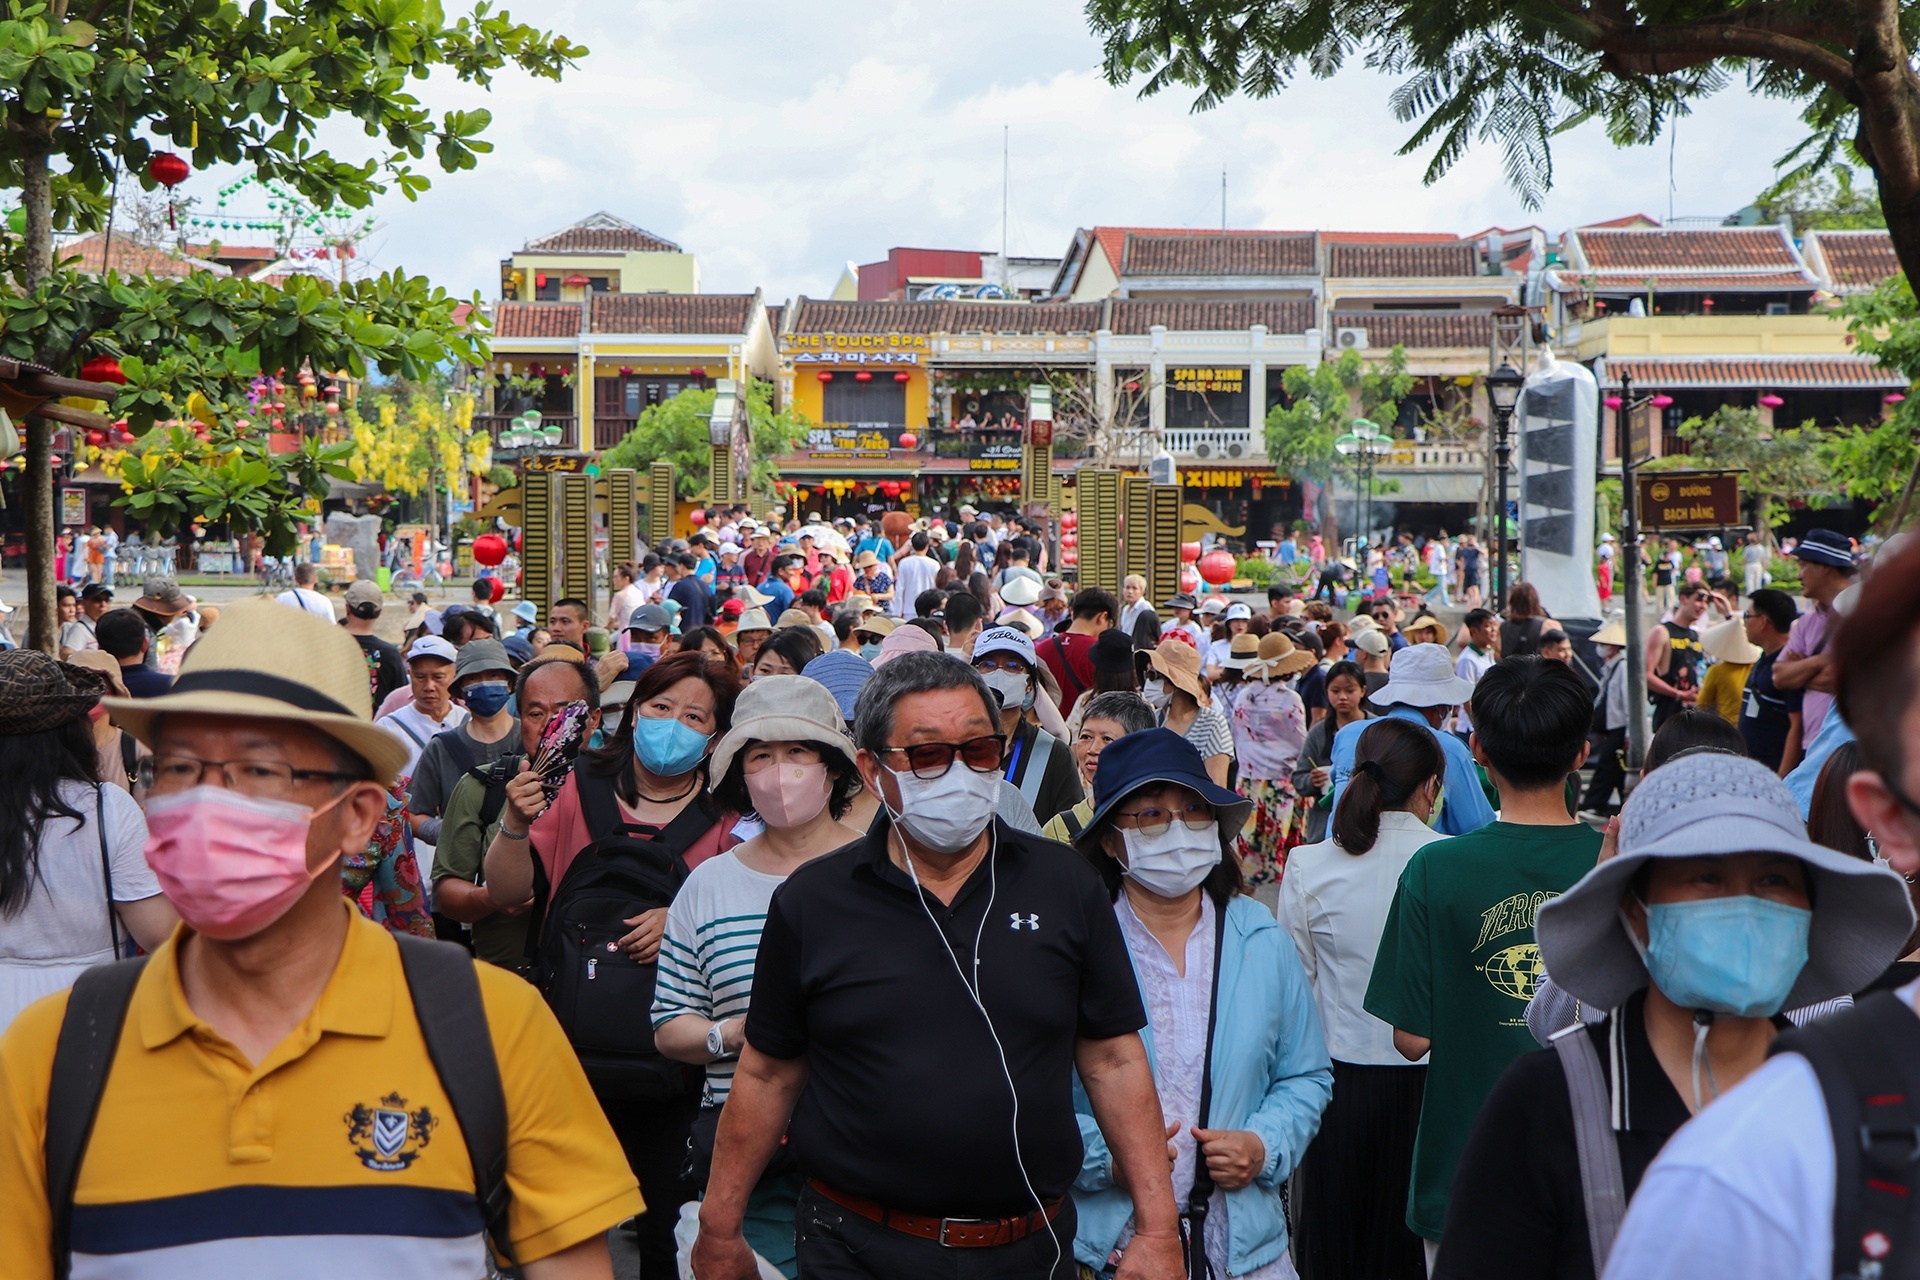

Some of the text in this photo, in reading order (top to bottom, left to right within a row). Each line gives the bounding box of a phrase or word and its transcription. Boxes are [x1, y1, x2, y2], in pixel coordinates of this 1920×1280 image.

[786, 334, 925, 347] THE TOUCH SPA
[1174, 368, 1196, 381] SPA
[808, 429, 832, 444] SPA
[1186, 471, 1242, 488] XINH
[1679, 483, 1711, 497] ĐƯỜNG
[1663, 507, 1688, 522] BẠCH
[983, 630, 1027, 646] Titleist
